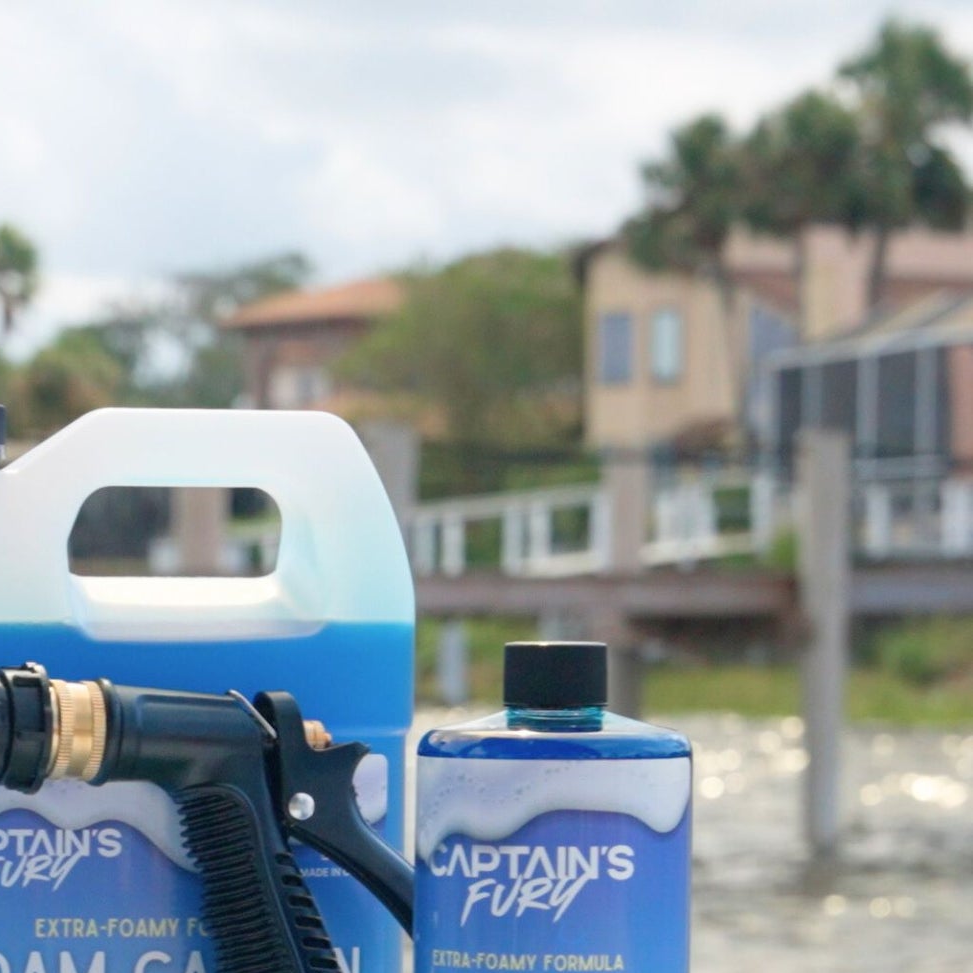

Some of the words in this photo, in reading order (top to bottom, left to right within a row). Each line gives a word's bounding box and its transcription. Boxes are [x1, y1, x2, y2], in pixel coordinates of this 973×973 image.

[430, 844, 636, 880] CAPTAIN'S
[460, 873, 591, 927] FURY
[35, 918, 179, 938] EXTRA-FOAMY
[432, 949, 537, 970] EXTRA-FOAMY
[543, 954, 624, 972] FORMULA
